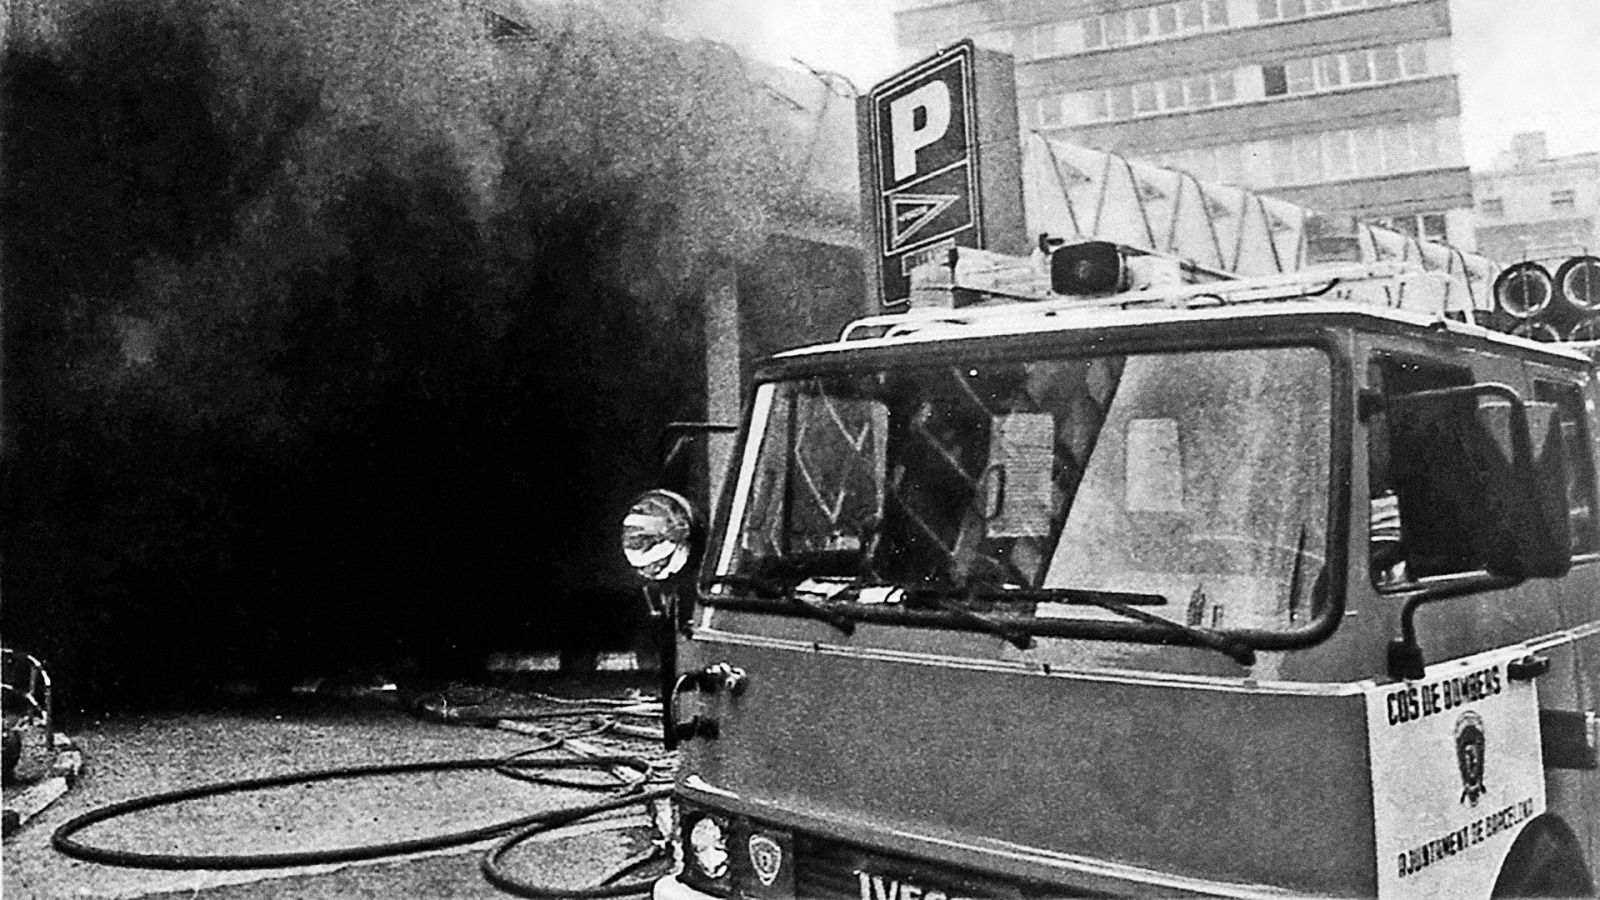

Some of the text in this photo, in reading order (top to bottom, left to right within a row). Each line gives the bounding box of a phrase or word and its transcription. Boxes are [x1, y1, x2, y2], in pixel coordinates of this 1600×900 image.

[890, 80, 951, 182] P
[1387, 665, 1501, 726] COS DE BOMBERS
[859, 871, 978, 900] IVE
